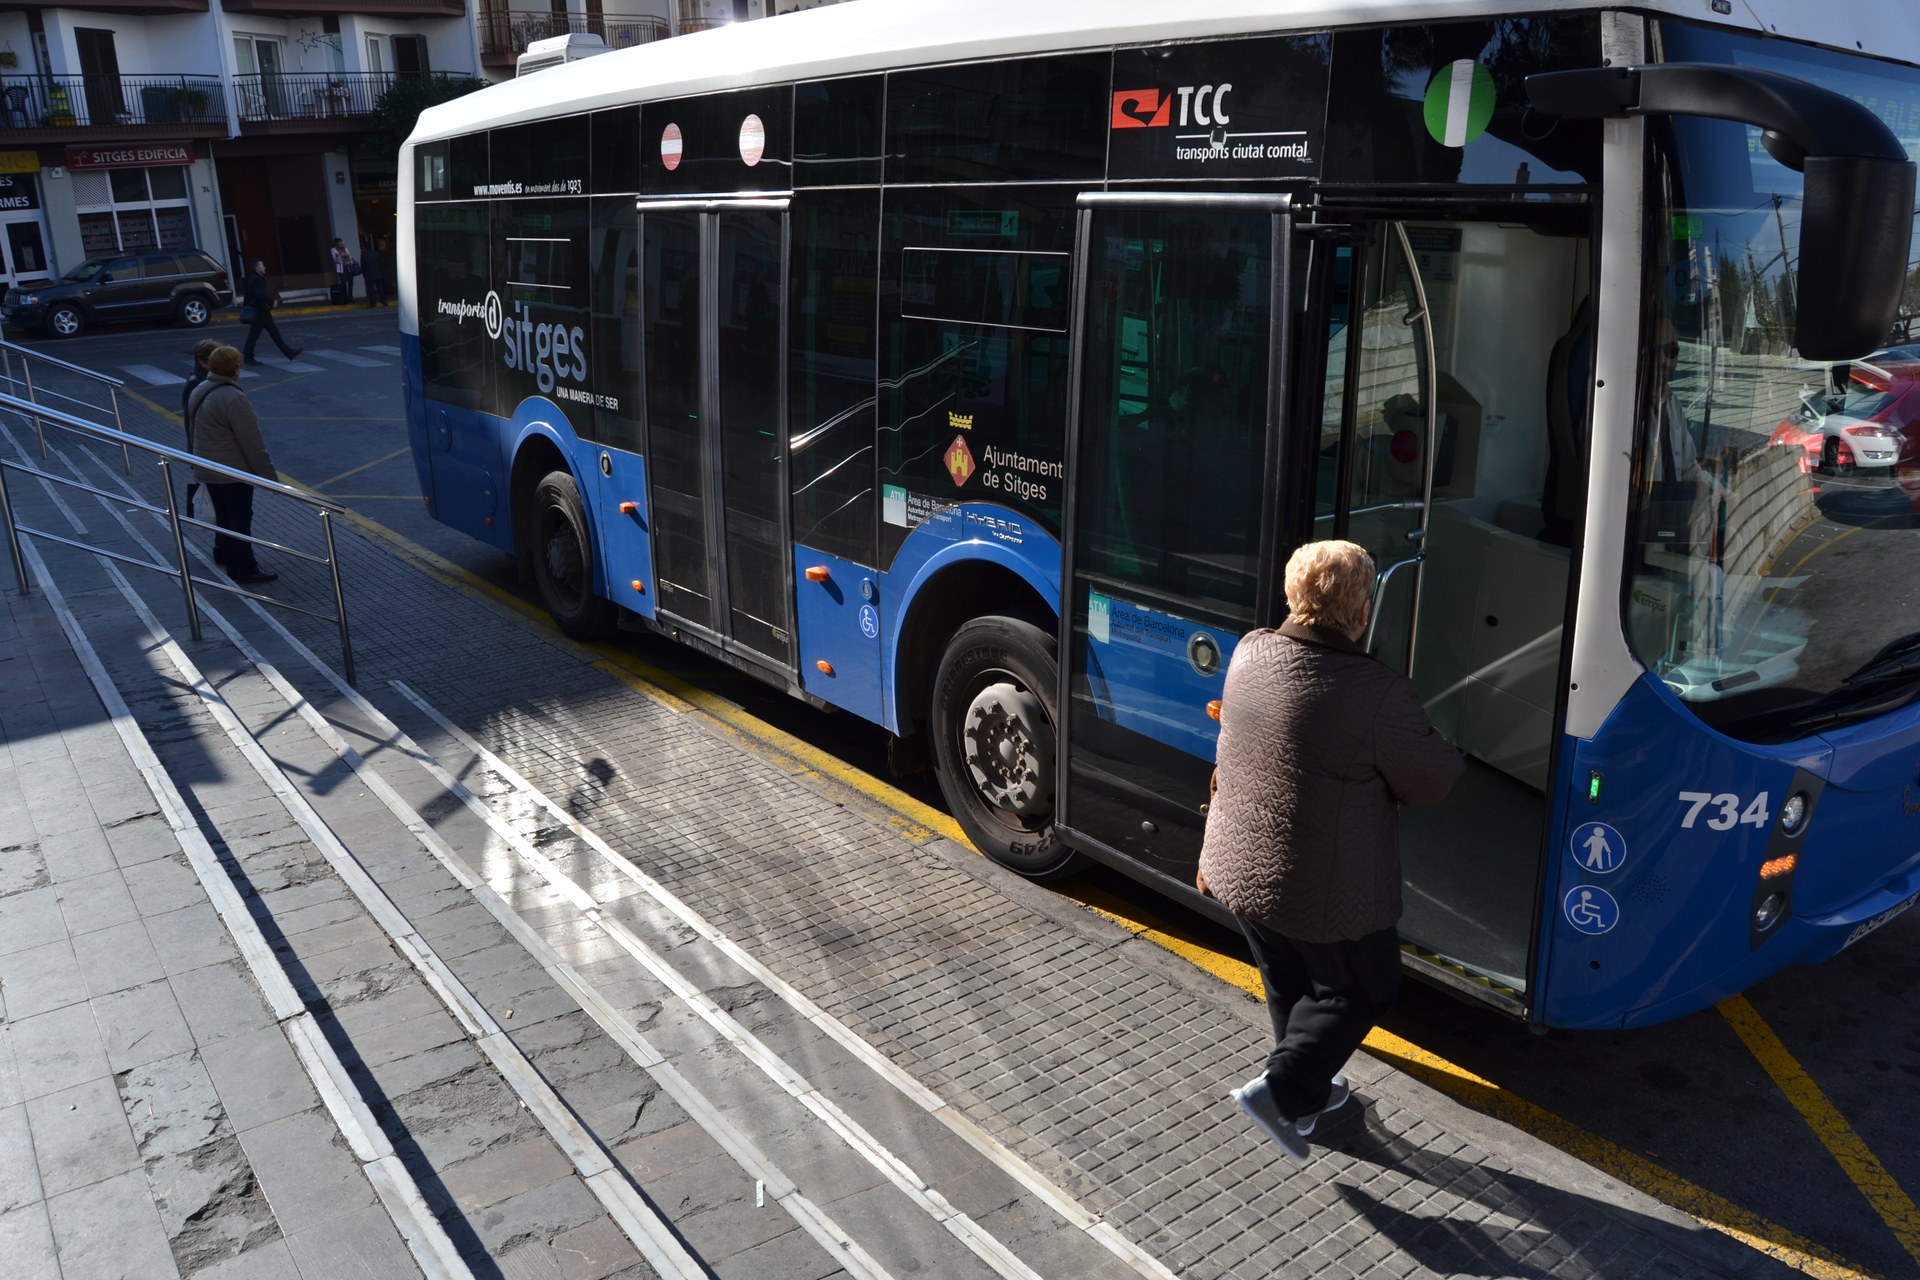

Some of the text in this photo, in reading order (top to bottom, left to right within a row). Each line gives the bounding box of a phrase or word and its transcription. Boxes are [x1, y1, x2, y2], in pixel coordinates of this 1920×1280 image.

[1177, 83, 1233, 127] TCC
[92, 148, 188, 164] SITGES EDIFICIA
[1176, 141, 1308, 163] transports ciutat comtal
[473, 180, 523, 196] www.moventis.es
[567, 179, 582, 194] 1923
[437, 298, 485, 325] transports
[502, 300, 587, 394] sitges
[556, 386, 619, 411] UNA MANERA DE SER
[983, 445, 1063, 479] Ajuntament
[889, 490, 905, 502] ATM
[983, 469, 1047, 501] de Sitges
[922, 498, 930, 509] de
[1131, 613, 1142, 625] de
[1144, 615, 1185, 638] Barcelona
[1678, 791, 1769, 831] 734
